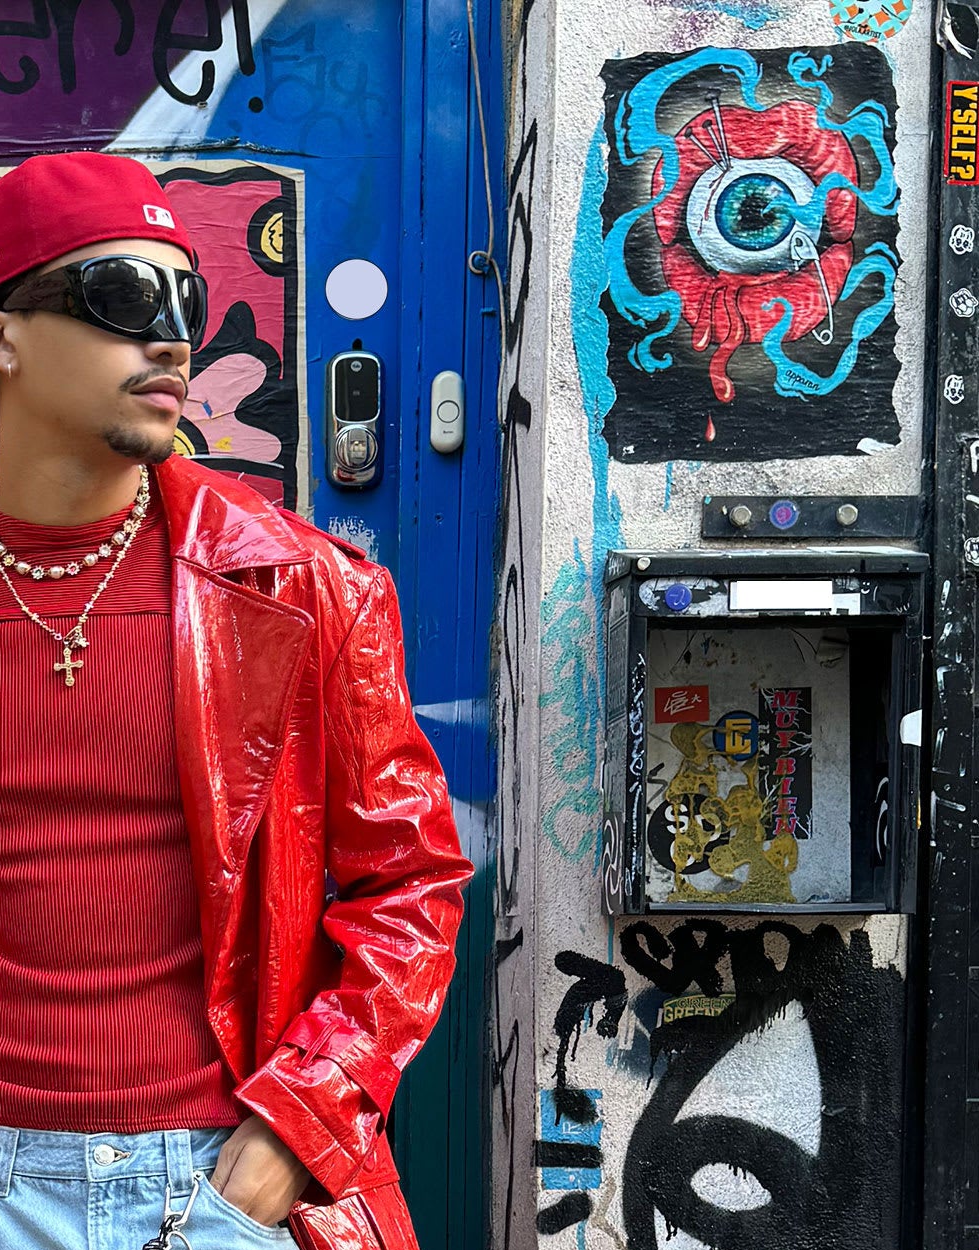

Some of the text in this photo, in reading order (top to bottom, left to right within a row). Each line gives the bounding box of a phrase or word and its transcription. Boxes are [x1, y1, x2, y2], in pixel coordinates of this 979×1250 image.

[951, 86, 978, 180] Y'SELF?
[772, 689, 800, 836] MUY BIEN
